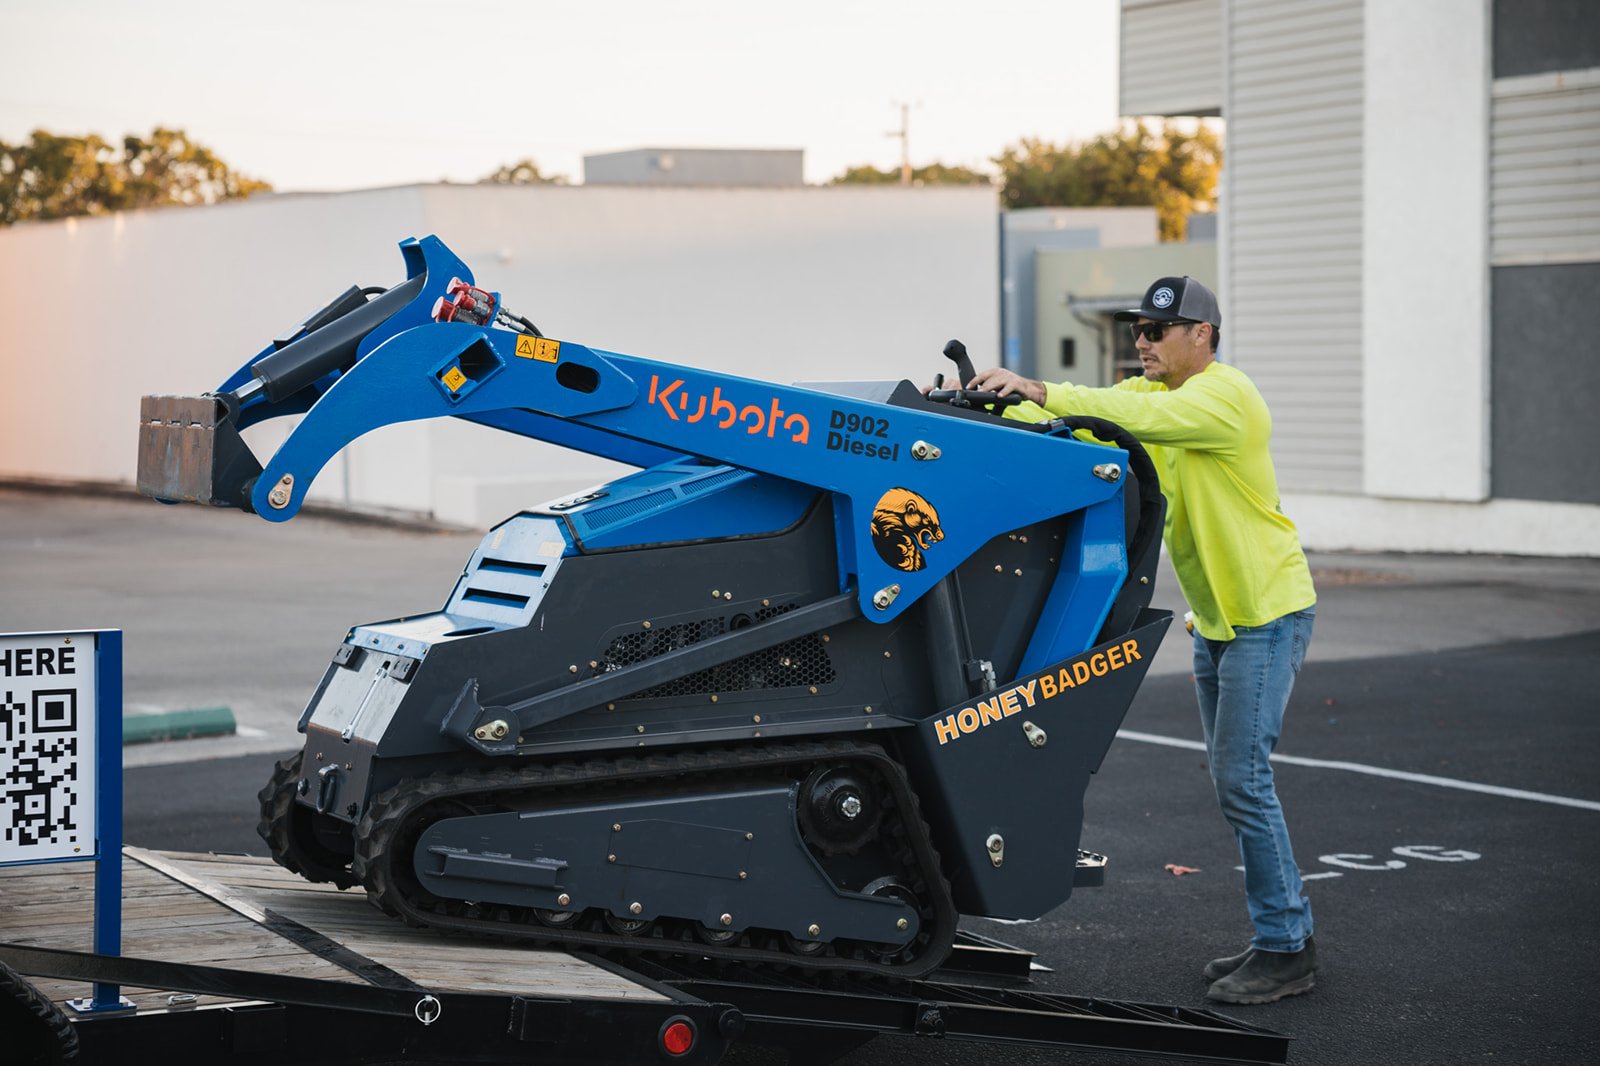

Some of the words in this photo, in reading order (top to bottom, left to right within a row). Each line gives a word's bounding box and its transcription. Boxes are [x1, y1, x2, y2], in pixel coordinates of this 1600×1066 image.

[648, 375, 810, 444] Kubota
[830, 410, 889, 439] D902
[827, 432, 899, 461] Diesel
